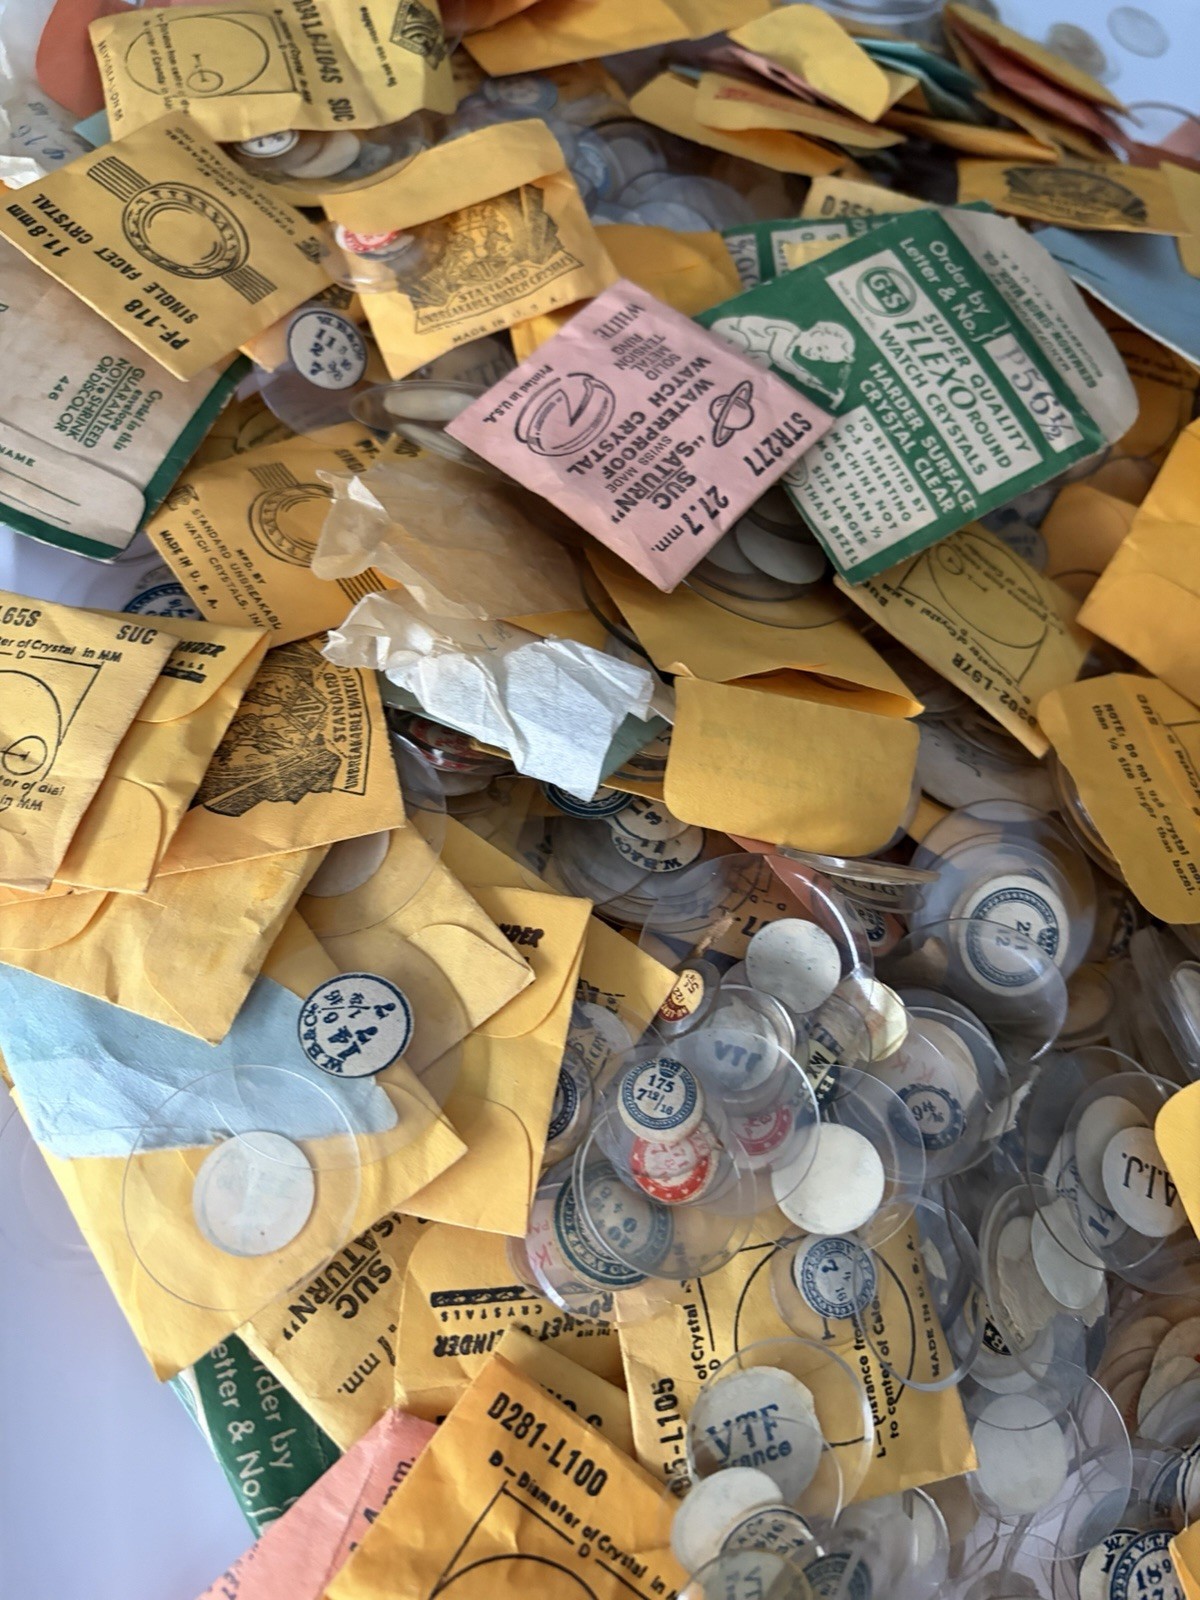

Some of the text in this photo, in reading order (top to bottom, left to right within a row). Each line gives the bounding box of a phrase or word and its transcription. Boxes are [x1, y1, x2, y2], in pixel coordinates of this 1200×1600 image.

[327, 94, 356, 125] SUC
[31, 194, 199, 324] SINGLE FACET CRYSTAL
[455, 267, 531, 303] STANDARD
[898, 233, 981, 338] Letter & No.
[926, 235, 993, 319] Order by
[124, 299, 190, 349] PF-118
[417, 292, 494, 327] UNBREAKABLE
[491, 280, 530, 302] WATCH
[451, 325, 488, 344] MADE
[491, 317, 505, 327] IN
[591, 294, 645, 348] WHITE
[103, 355, 130, 387] NOT
[609, 326, 643, 361] RING
[612, 325, 665, 377] TENSION
[629, 338, 669, 378] METAL
[643, 347, 682, 386] SOLID
[46, 373, 71, 403] 446
[53, 353, 114, 435] OR DISCOLOR
[508, 389, 522, 403] in
[517, 360, 554, 397] Printed
[877, 326, 988, 478] WATCH CRYSTALS
[892, 308, 981, 420] FLEXO
[964, 408, 1013, 472] ROUND
[922, 309, 1032, 457] SUPER QUALITY
[65, 392, 102, 442] SHRINK
[81, 362, 146, 453] GUARANTEED
[108, 386, 145, 434] envelope
[112, 386, 164, 454] Crystal in this
[565, 348, 711, 485] WATCH CRYSTAL
[598, 370, 715, 485] WATERPROOF
[604, 432, 673, 496] SWISS MADE
[739, 406, 814, 480] STR277
[857, 376, 918, 455] CRYSTAL
[910, 455, 958, 515] CLEAR
[857, 414, 928, 515] TO BE FITTED BY
[867, 359, 979, 515] HARDER SURFACE
[649, 465, 698, 514] SUC
[815, 438, 875, 523] MORE THAN
[828, 430, 900, 532] MACHINE NOT
[843, 422, 915, 523] G-S INSERTING
[189, 505, 233, 561] STANDARD
[676, 482, 732, 537] 27.7
[801, 482, 860, 565] THAN BEZEL
[810, 464, 870, 547] SIZE LARGER
[158, 527, 184, 557] MADE
[177, 554, 193, 570] IN
[182, 519, 211, 555] WATCH
[251, 571, 267, 588] BY
[20, 638, 123, 664] of Crystal in MM
[116, 624, 159, 646] SUC
[330, 672, 348, 744] STANDARD
[343, 671, 366, 790] UNBREAKABLE WATCH
[1090, 703, 1111, 731] than
[1117, 754, 1137, 781] size
[1131, 783, 1158, 822] larger
[1154, 825, 1175, 854] than
[1123, 741, 1139, 760] Do
[1134, 762, 1153, 785] not
[1146, 787, 1165, 811] use
[1158, 812, 1190, 858] crystal
[327, 1025, 362, 1061] 14
[647, 1073, 676, 1094] 175
[334, 1257, 393, 1322] SUC
[439, 1304, 542, 1321] CRYSTALS
[683, 1303, 707, 1360] Crystal
[922, 1307, 941, 1378] MADE IN
[227, 1419, 256, 1444] &
[269, 1428, 294, 1469] by
[487, 1391, 608, 1497] D281-L100
[706, 1402, 781, 1464] VTF
[888, 1423, 900, 1439] to
[236, 1449, 267, 1502] No.
[517, 1472, 670, 1595] Diameter of Crystal in
